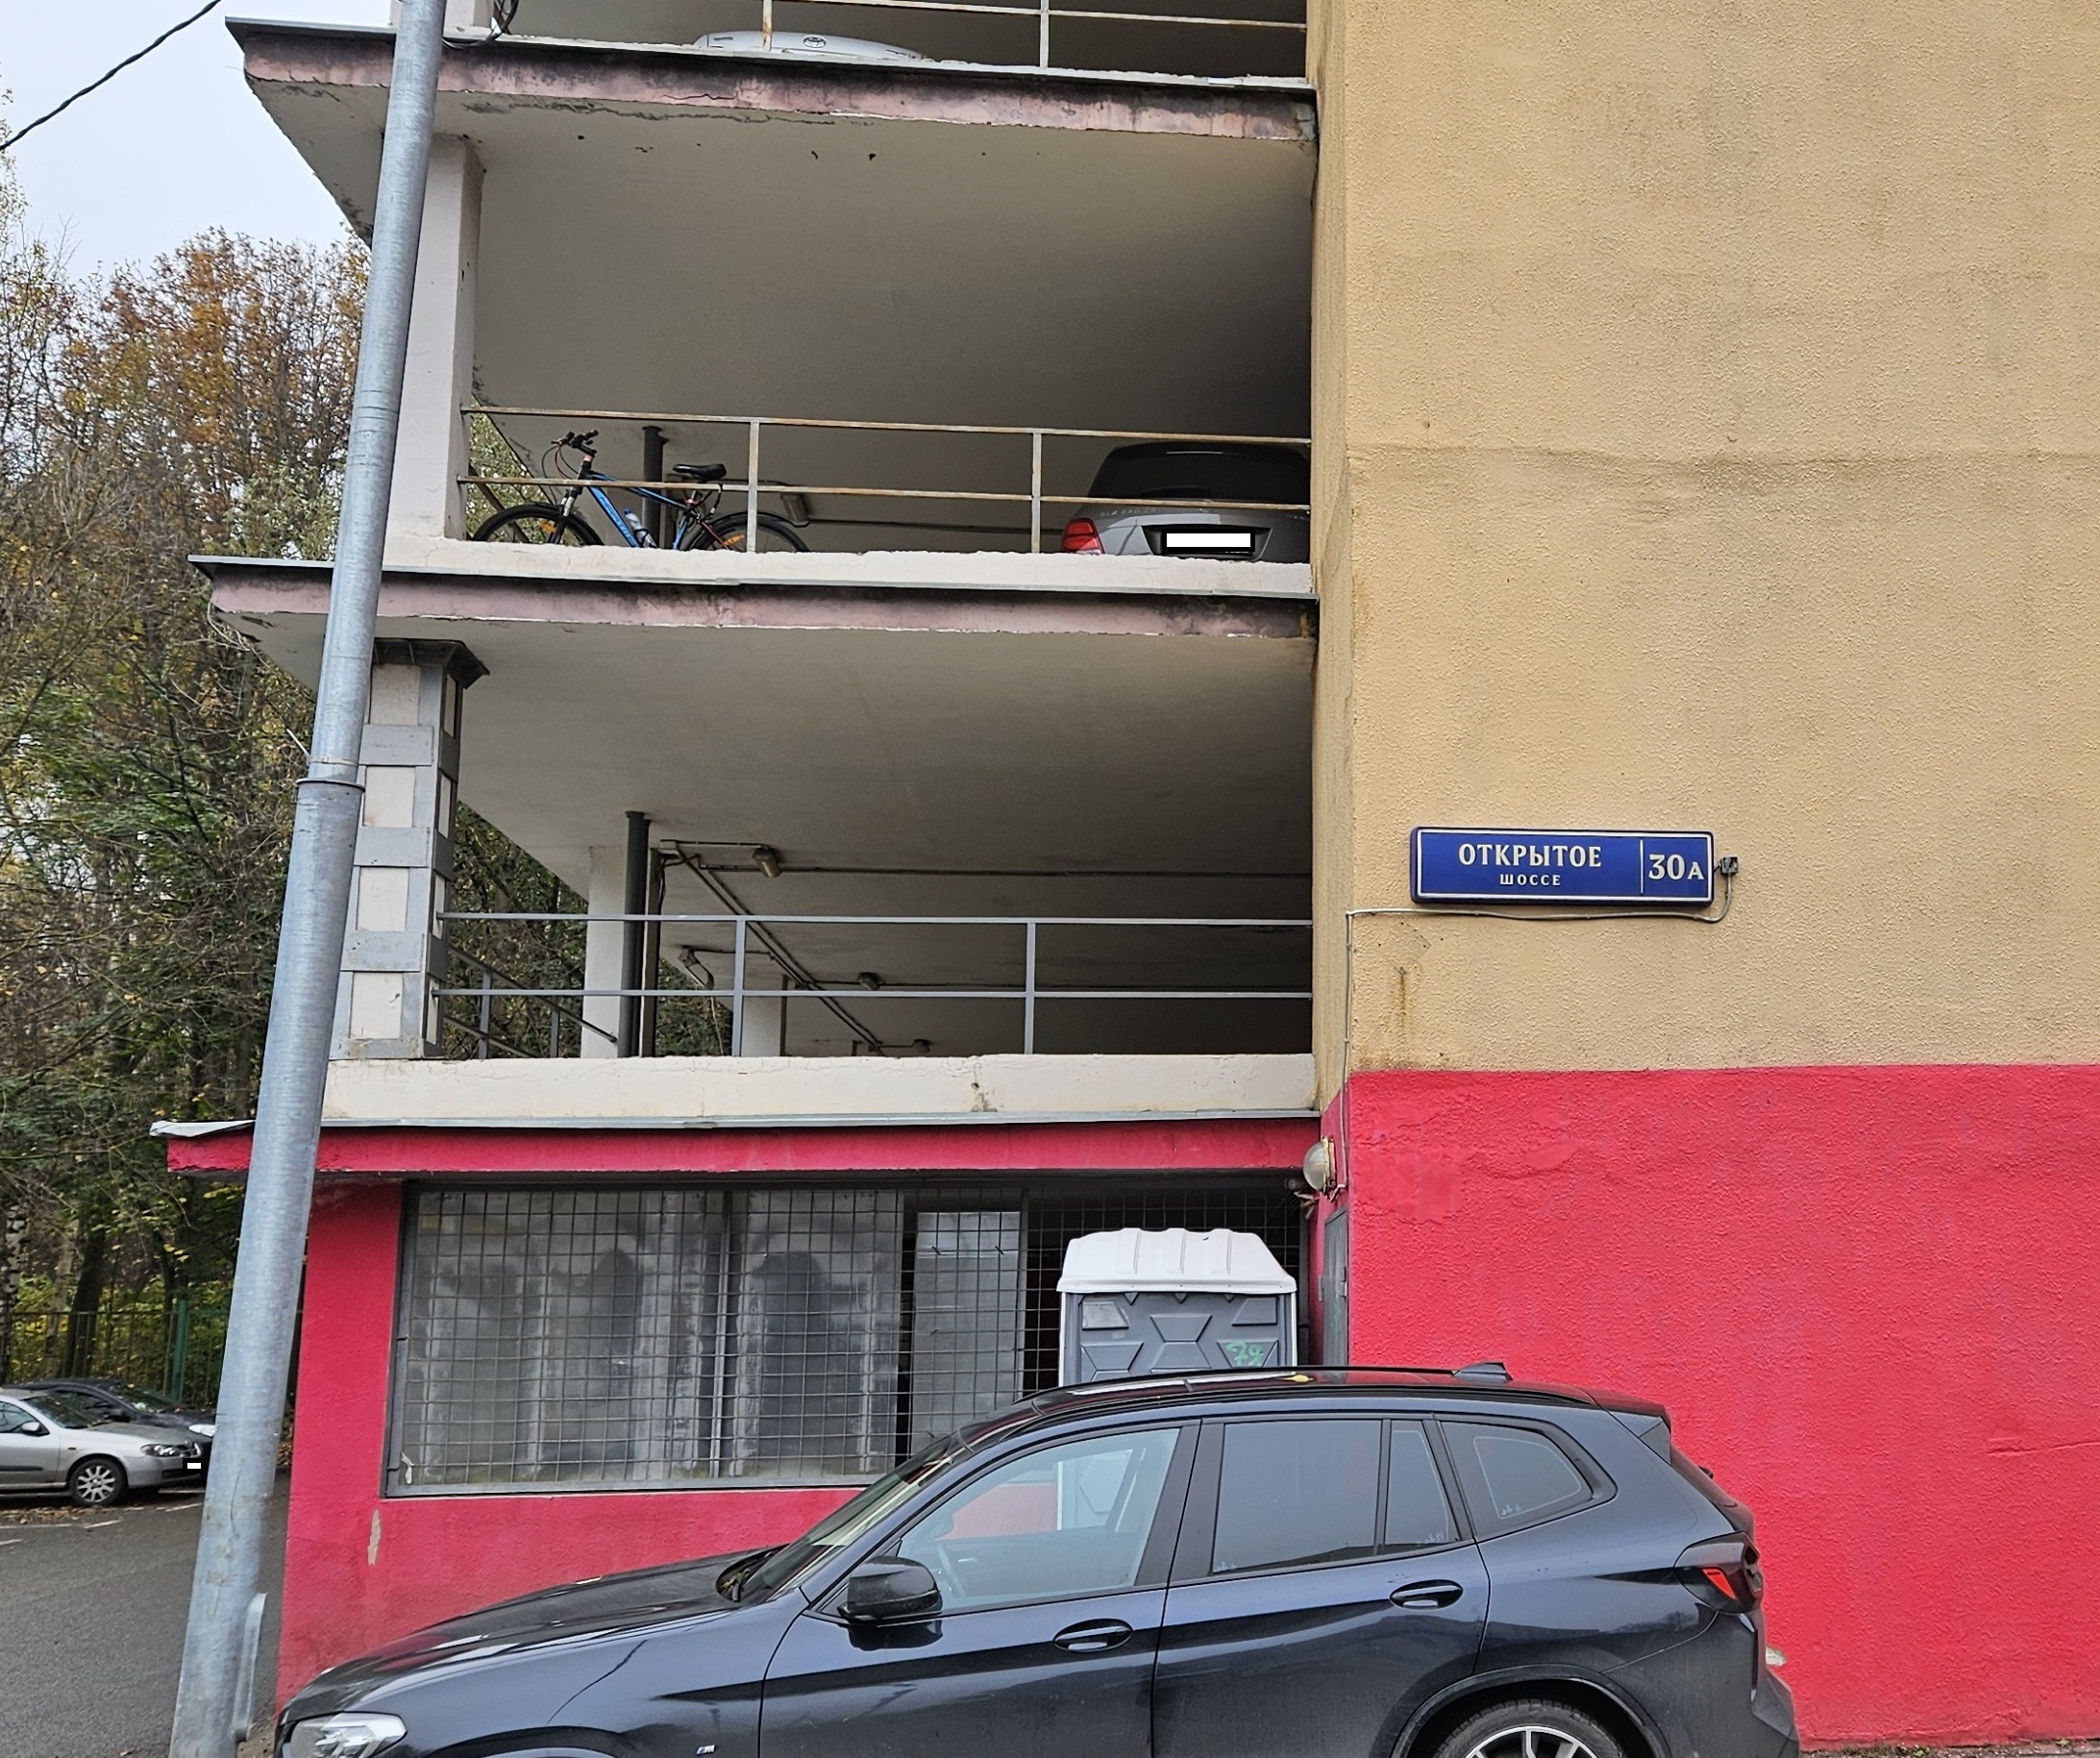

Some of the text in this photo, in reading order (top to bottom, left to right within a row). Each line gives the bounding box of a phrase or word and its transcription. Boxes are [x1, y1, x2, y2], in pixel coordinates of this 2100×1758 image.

[1458, 843, 1602, 867] ОТКРЫТОЕ
[1648, 854, 1705, 879] 30А
[1499, 873, 1561, 886] ШОССЕ
